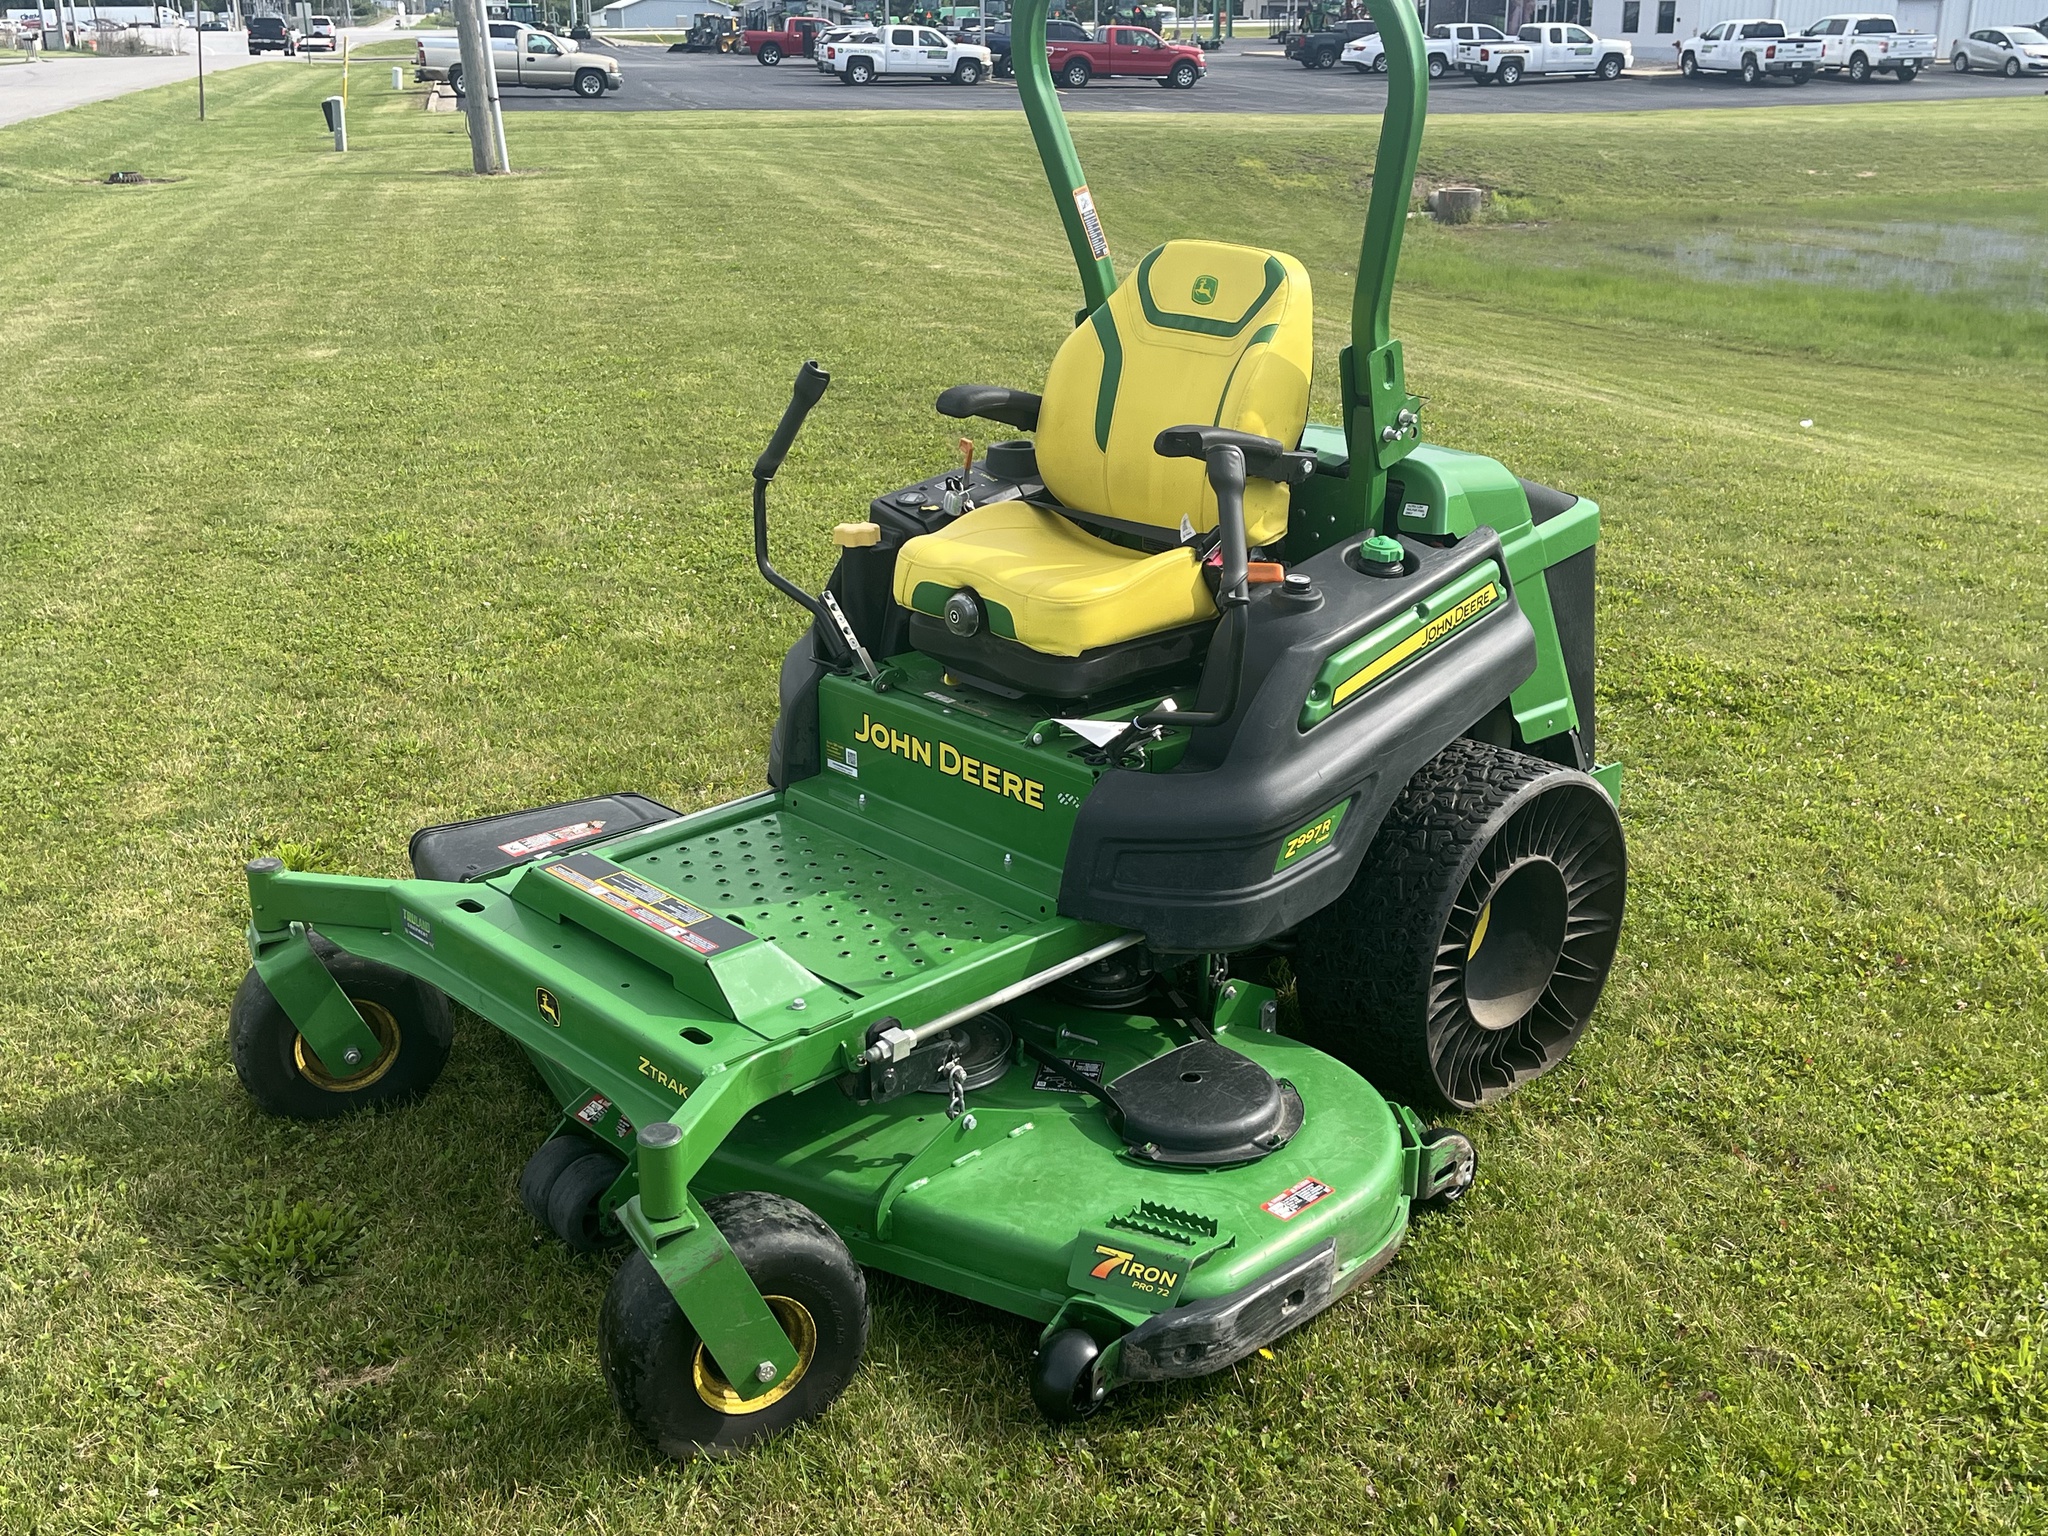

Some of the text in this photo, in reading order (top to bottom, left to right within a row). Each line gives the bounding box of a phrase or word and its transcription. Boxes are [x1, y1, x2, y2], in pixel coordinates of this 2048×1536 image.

[1421, 590, 1491, 647] JOHN DEERE
[854, 712, 1045, 811] JOHN DEERE
[1284, 818, 1332, 859] Z997R
[638, 1055, 689, 1099] ZTRAK
[1131, 1280, 1170, 1298] PRO 72
